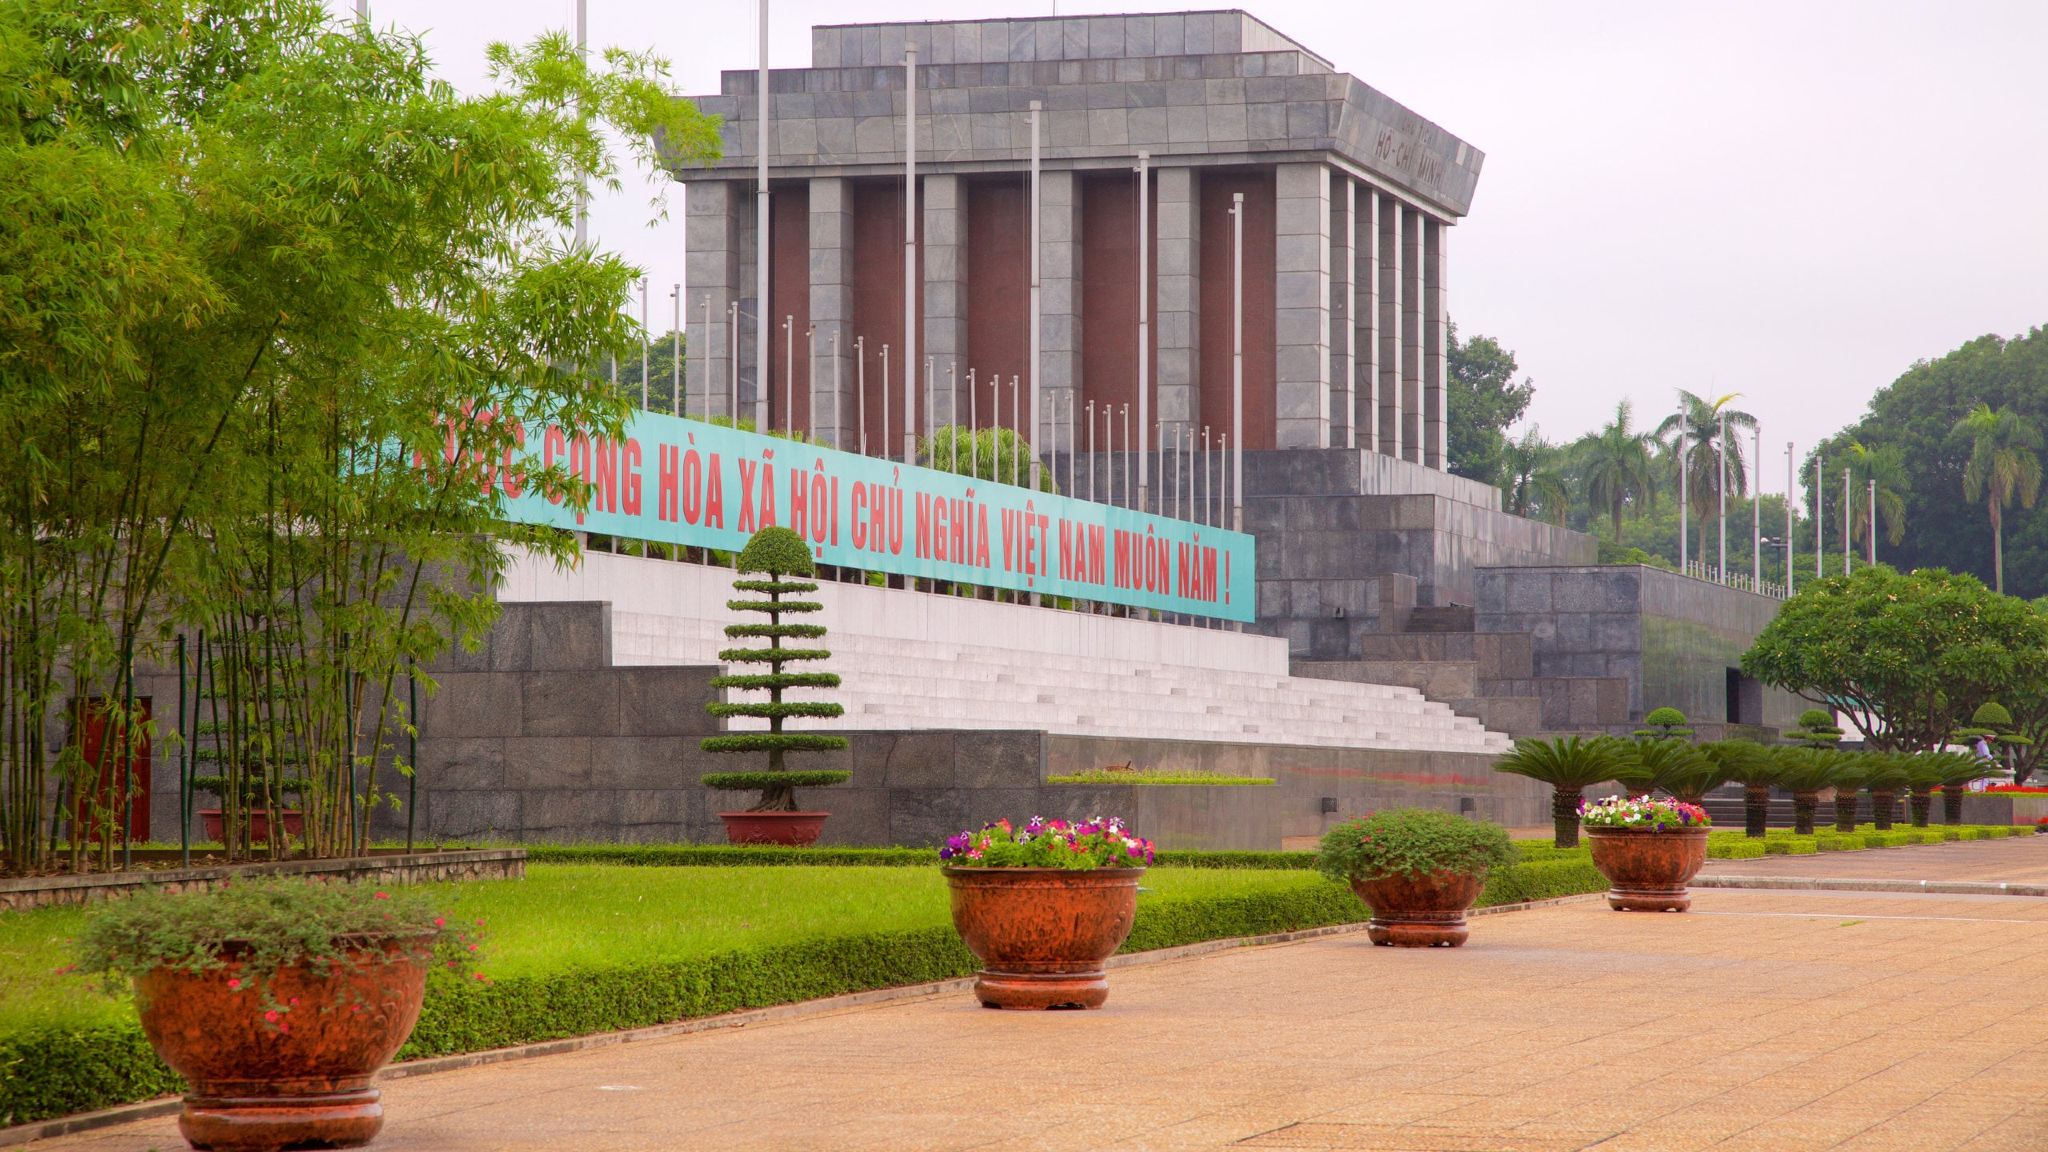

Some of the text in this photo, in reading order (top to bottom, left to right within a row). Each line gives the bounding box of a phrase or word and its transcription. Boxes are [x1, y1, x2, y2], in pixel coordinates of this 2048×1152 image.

[544, 410, 642, 526] CỘNG
[659, 432, 723, 529] HÒA
[738, 448, 777, 534] XÃ
[791, 458, 838, 558] HỘI
[851, 466, 903, 556] CHỦ
[916, 487, 990, 568] NGHĨA
[1001, 500, 1049, 587] VIỆT
[1059, 518, 1105, 585] NAM
[1114, 523, 1170, 595] MUÔN
[1178, 533, 1217, 602] NĂM
[1224, 550, 1230, 604] !
